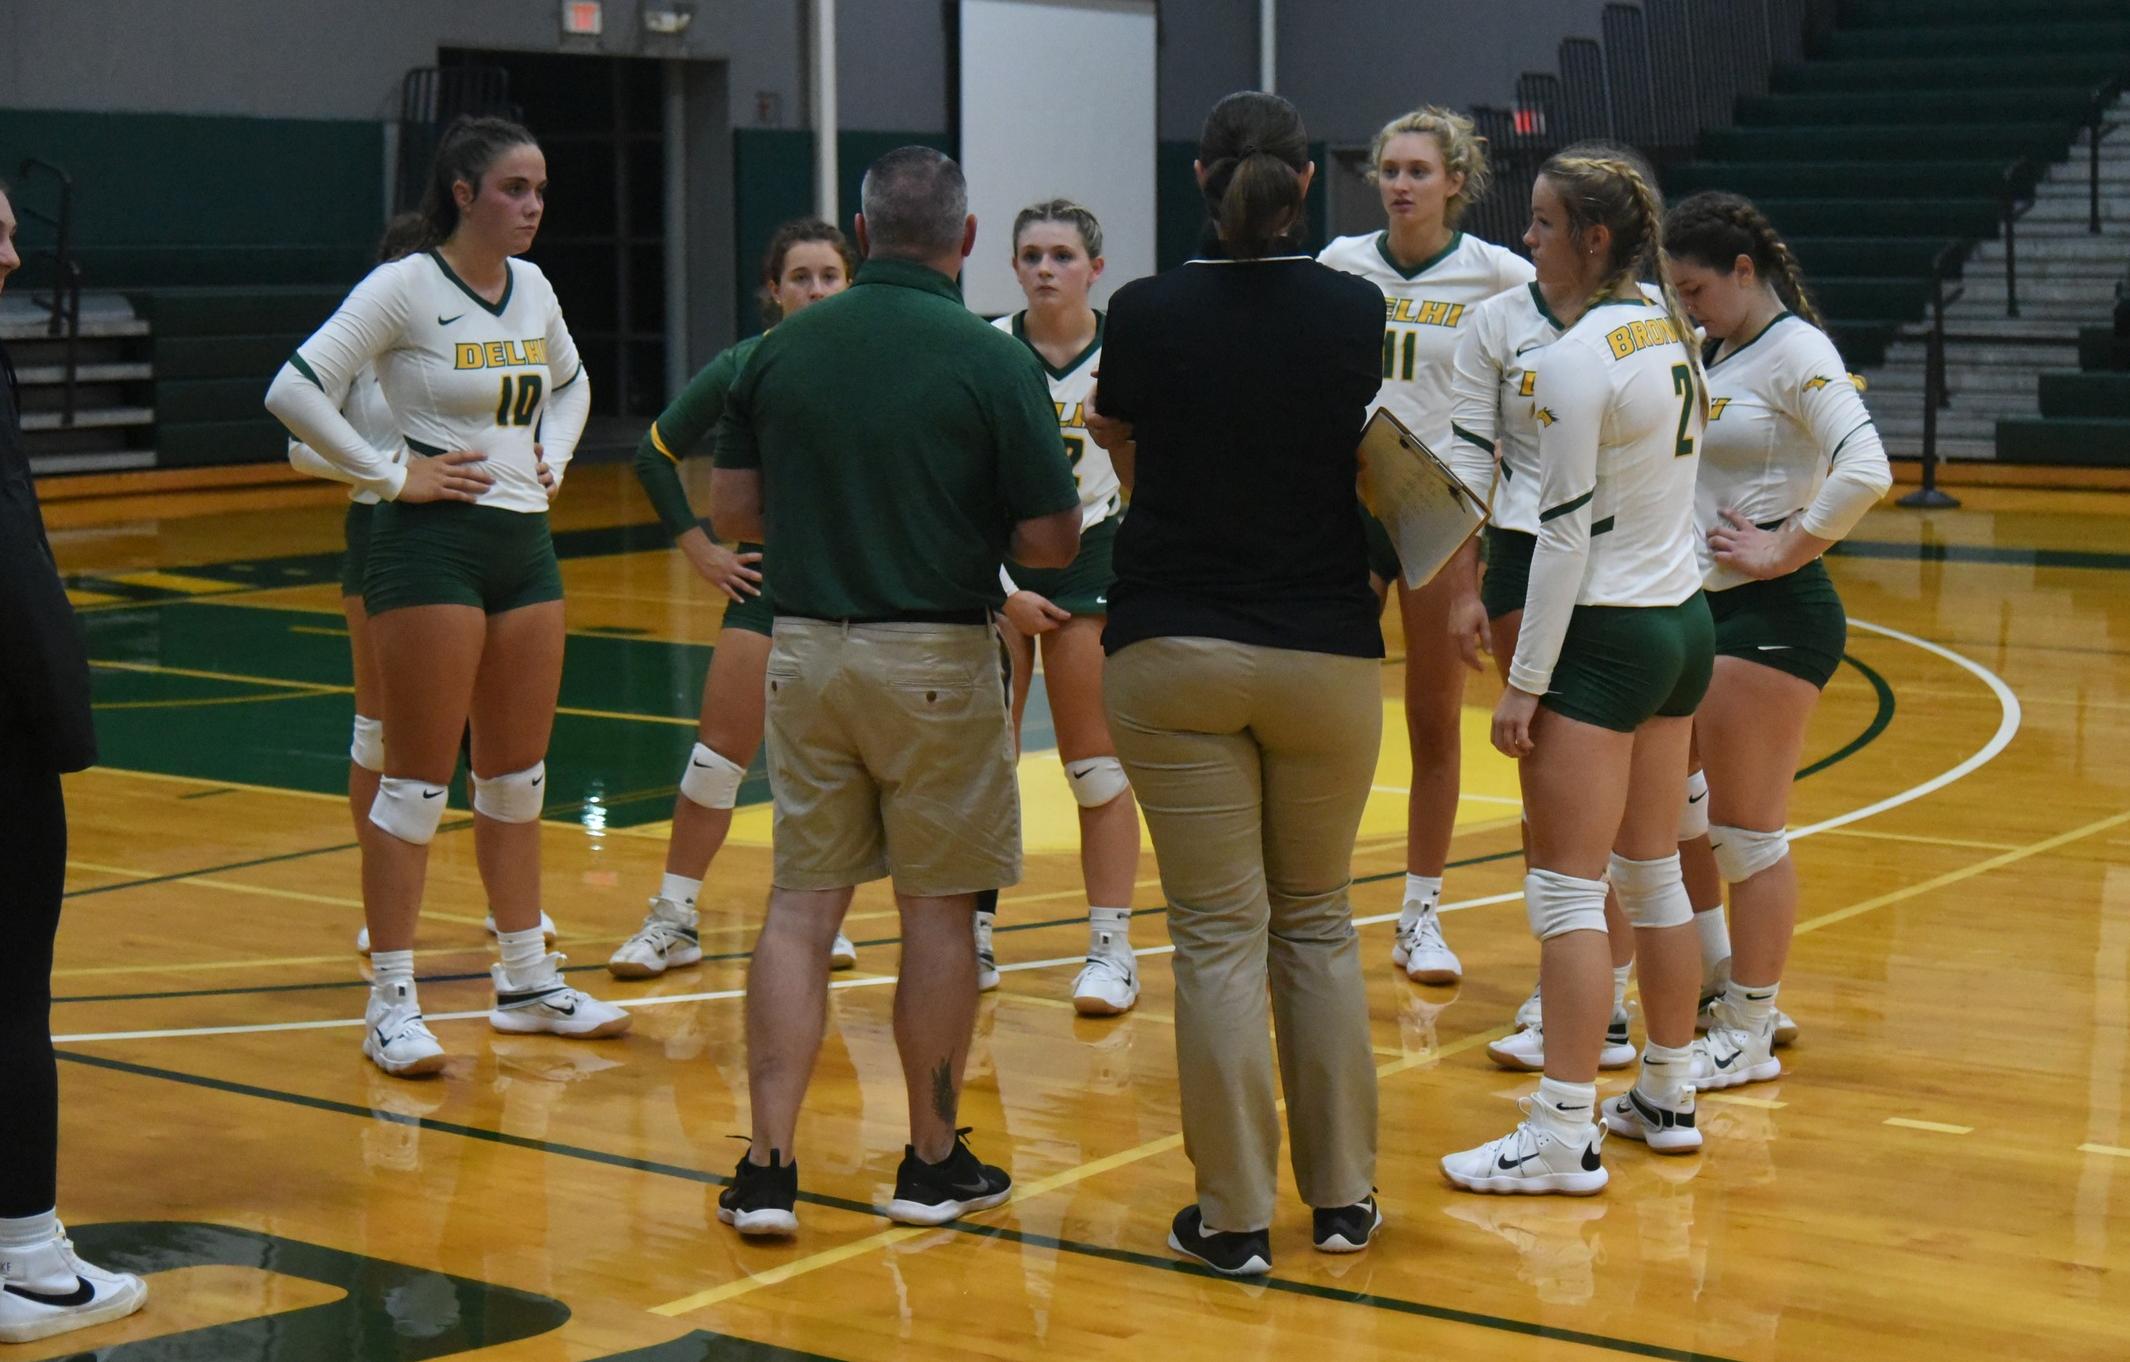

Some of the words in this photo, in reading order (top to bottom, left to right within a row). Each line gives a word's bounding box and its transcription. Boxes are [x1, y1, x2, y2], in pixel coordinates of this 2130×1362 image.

[1384, 296, 1466, 328] ELHI
[1382, 329, 1417, 381] 11
[1605, 316, 1679, 361] BRON
[496, 372, 543, 427] 10
[1671, 361, 1695, 459] 2
